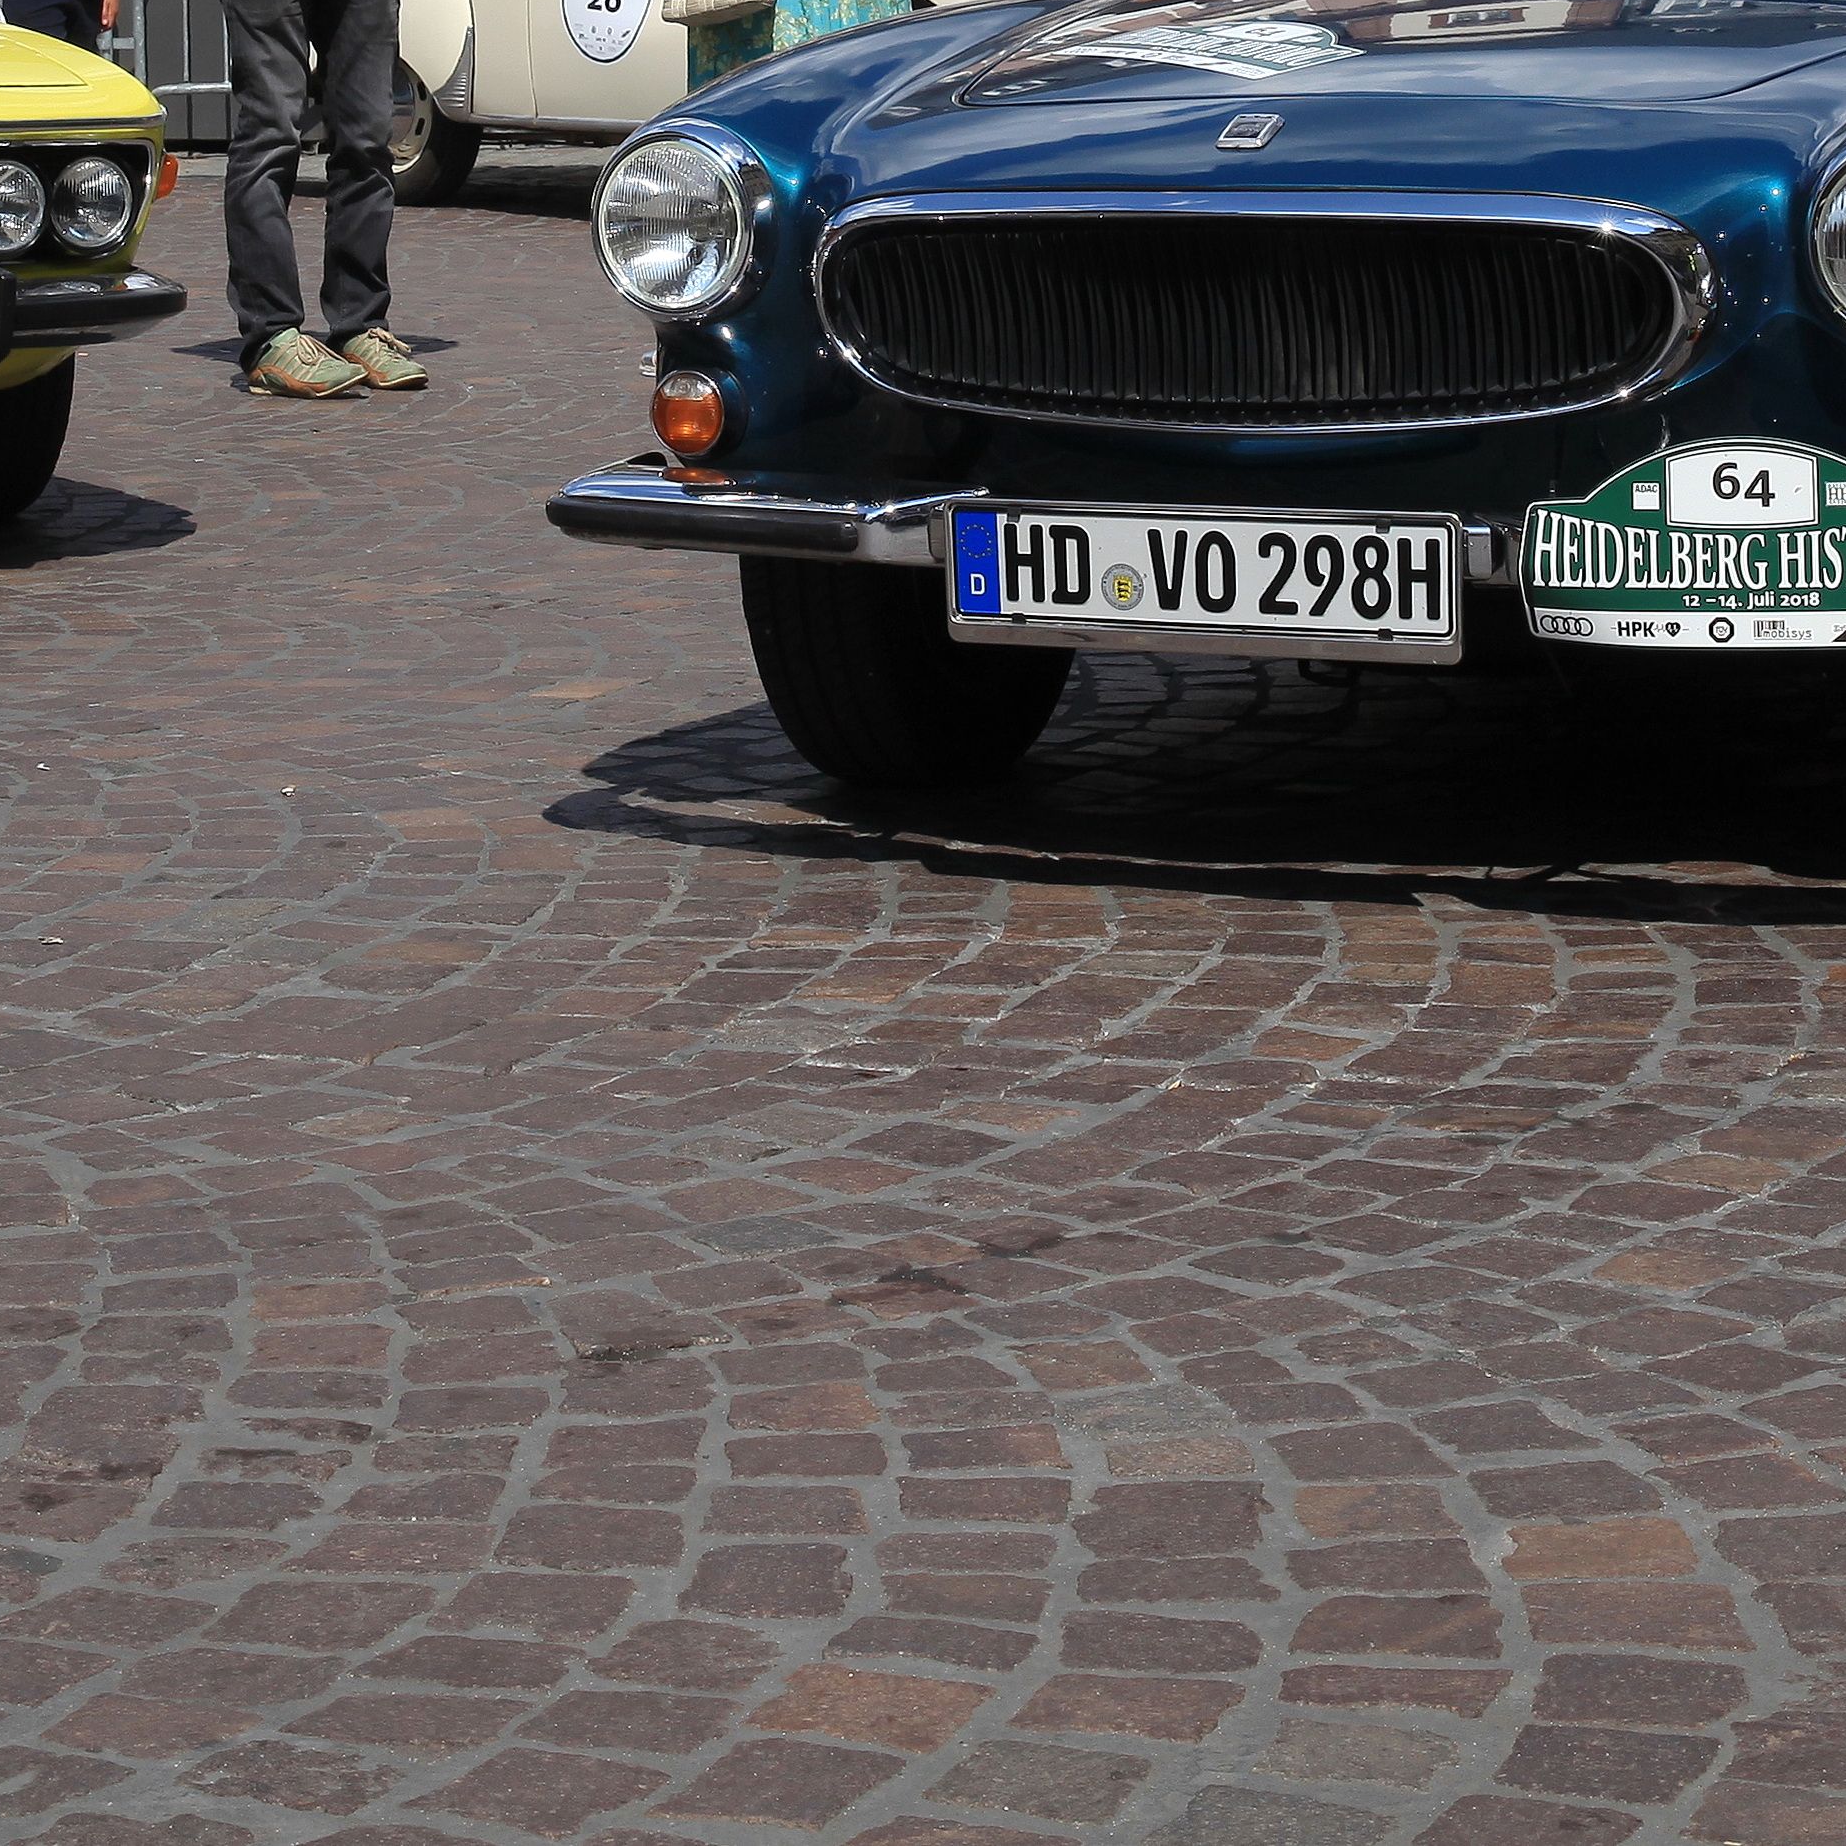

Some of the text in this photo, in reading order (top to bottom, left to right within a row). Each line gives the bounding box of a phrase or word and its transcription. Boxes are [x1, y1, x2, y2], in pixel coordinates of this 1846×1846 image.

[1633, 483, 1658, 494] ADAC
[1712, 461, 1776, 508] 64
[1531, 507, 1770, 590] HEIDELBERG
[1002, 522, 1092, 605] HD
[1256, 531, 1441, 621] 298H
[969, 572, 986, 596] D
[1682, 594, 1701, 607] 12
[1746, 590, 1775, 610] Juli
[1779, 591, 1821, 607] 2018
[1616, 620, 1656, 638] HPK
[1762, 625, 1813, 641] mobisys
